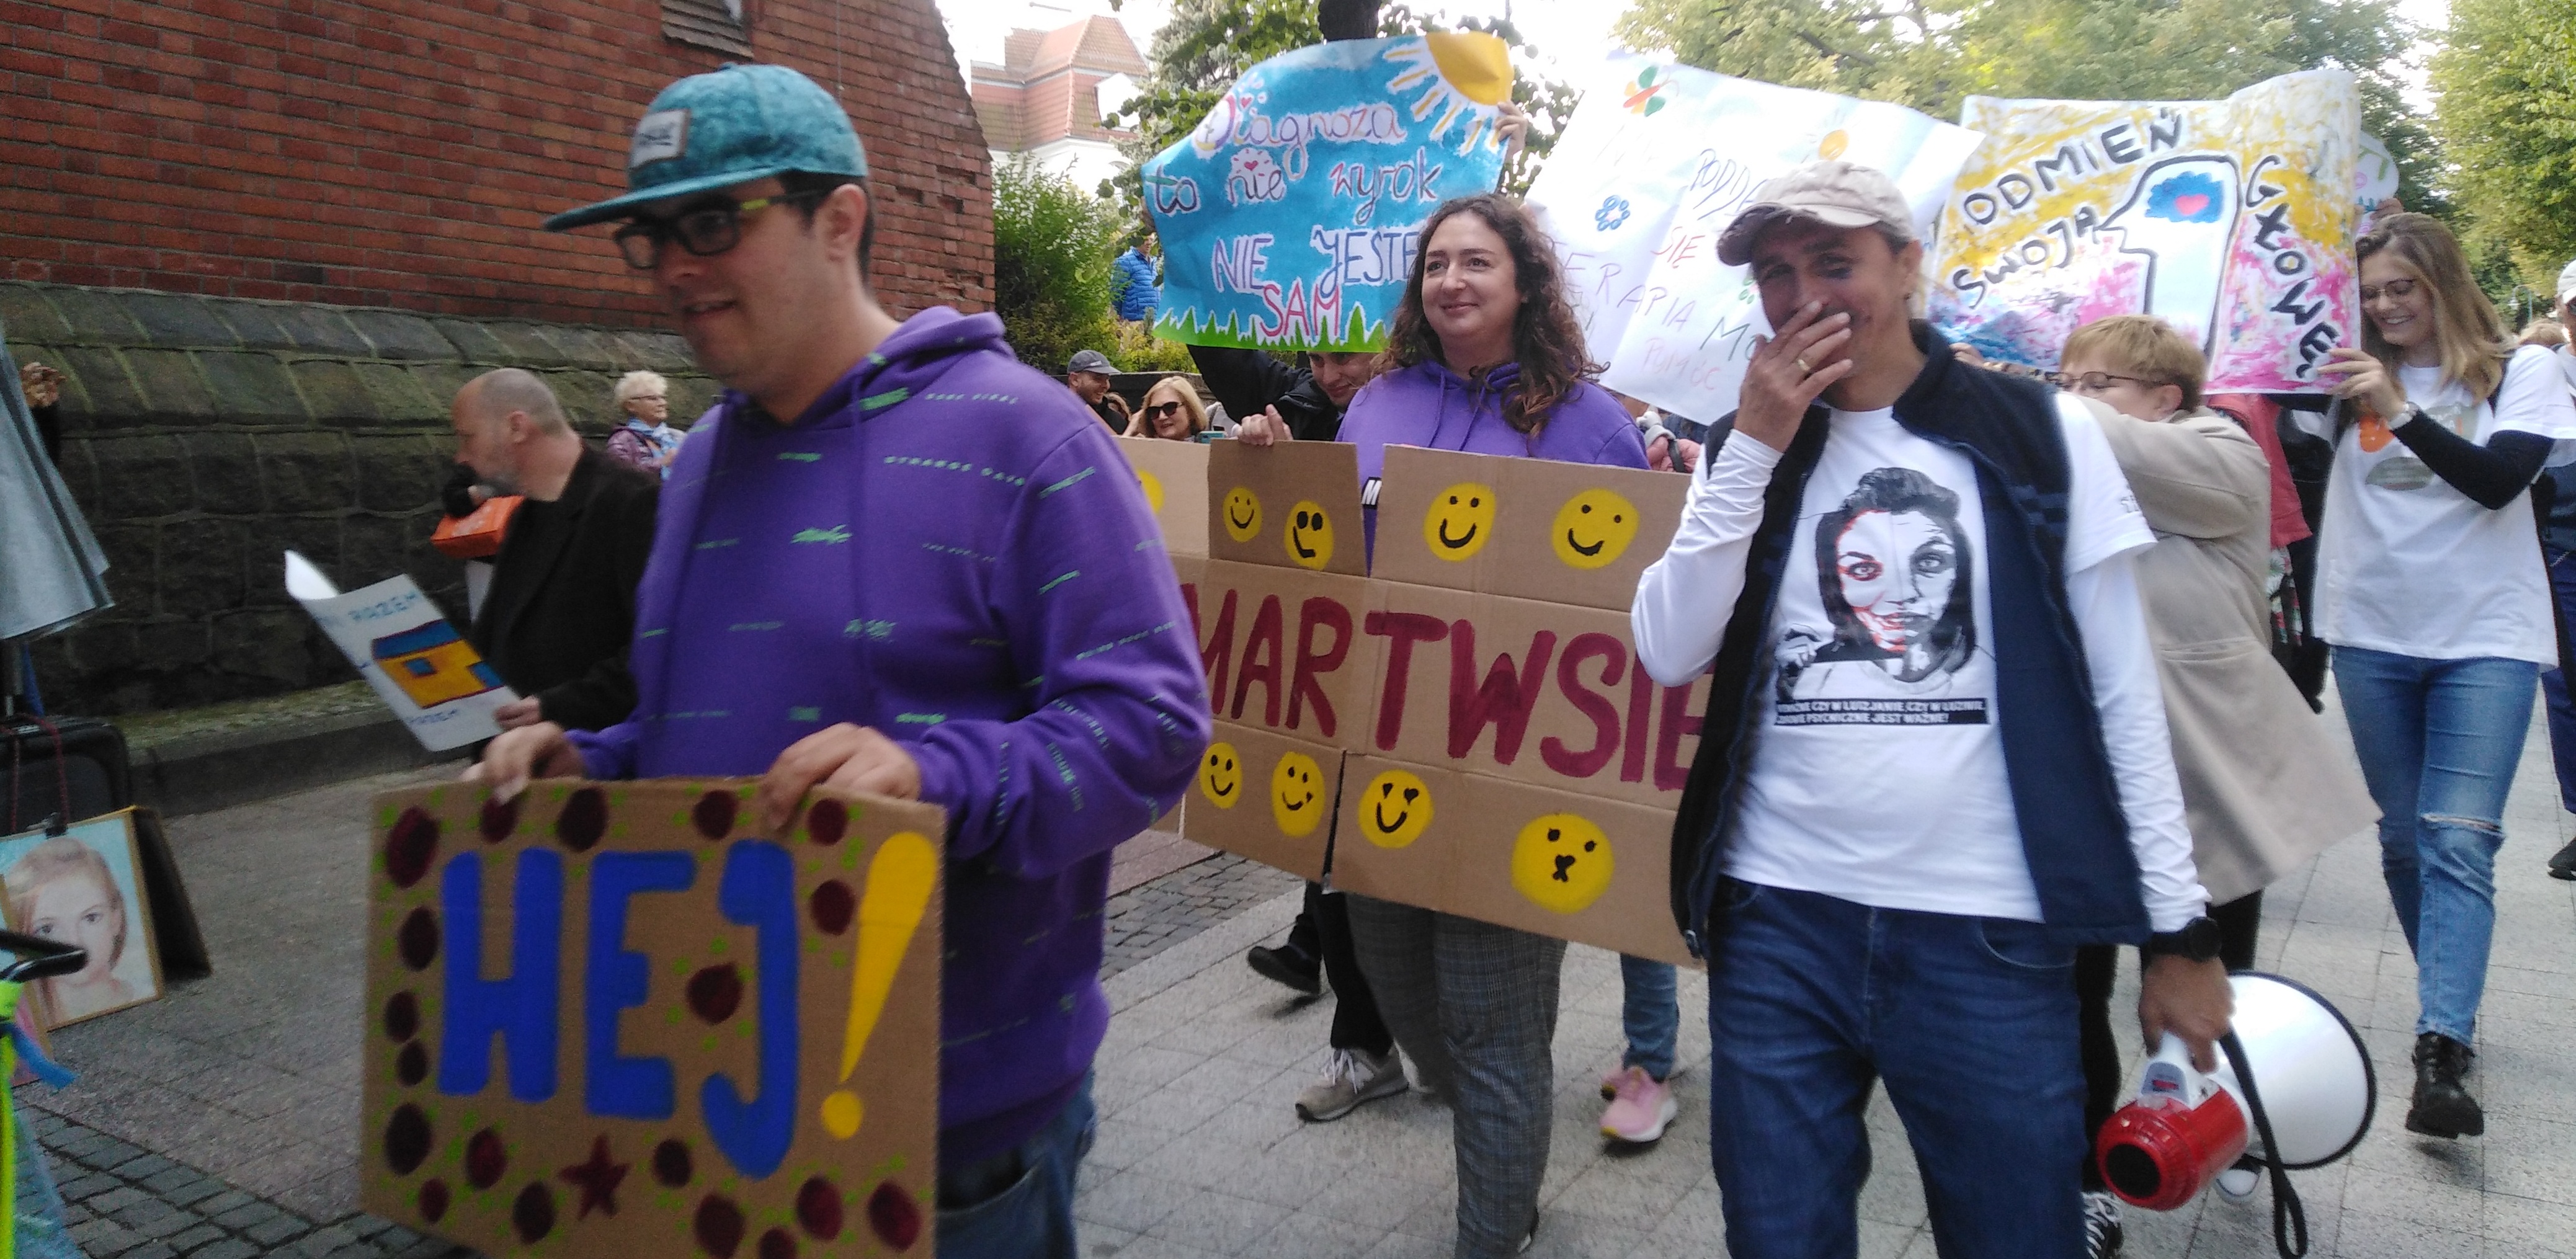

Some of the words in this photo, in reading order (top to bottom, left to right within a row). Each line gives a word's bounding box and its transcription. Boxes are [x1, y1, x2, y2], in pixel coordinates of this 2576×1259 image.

[1194, 93, 1407, 179] Diagnoza
[1146, 164, 1199, 213] to
[1228, 167, 1283, 203] nie
[1330, 149, 1442, 225] wyrok
[1213, 238, 1273, 291] NIE
[1313, 229, 1420, 299] JESTE
[1552, 240, 1697, 332] ERAPIA
[1260, 281, 1341, 337] SAM
[436, 830, 938, 1180] HEJ!
